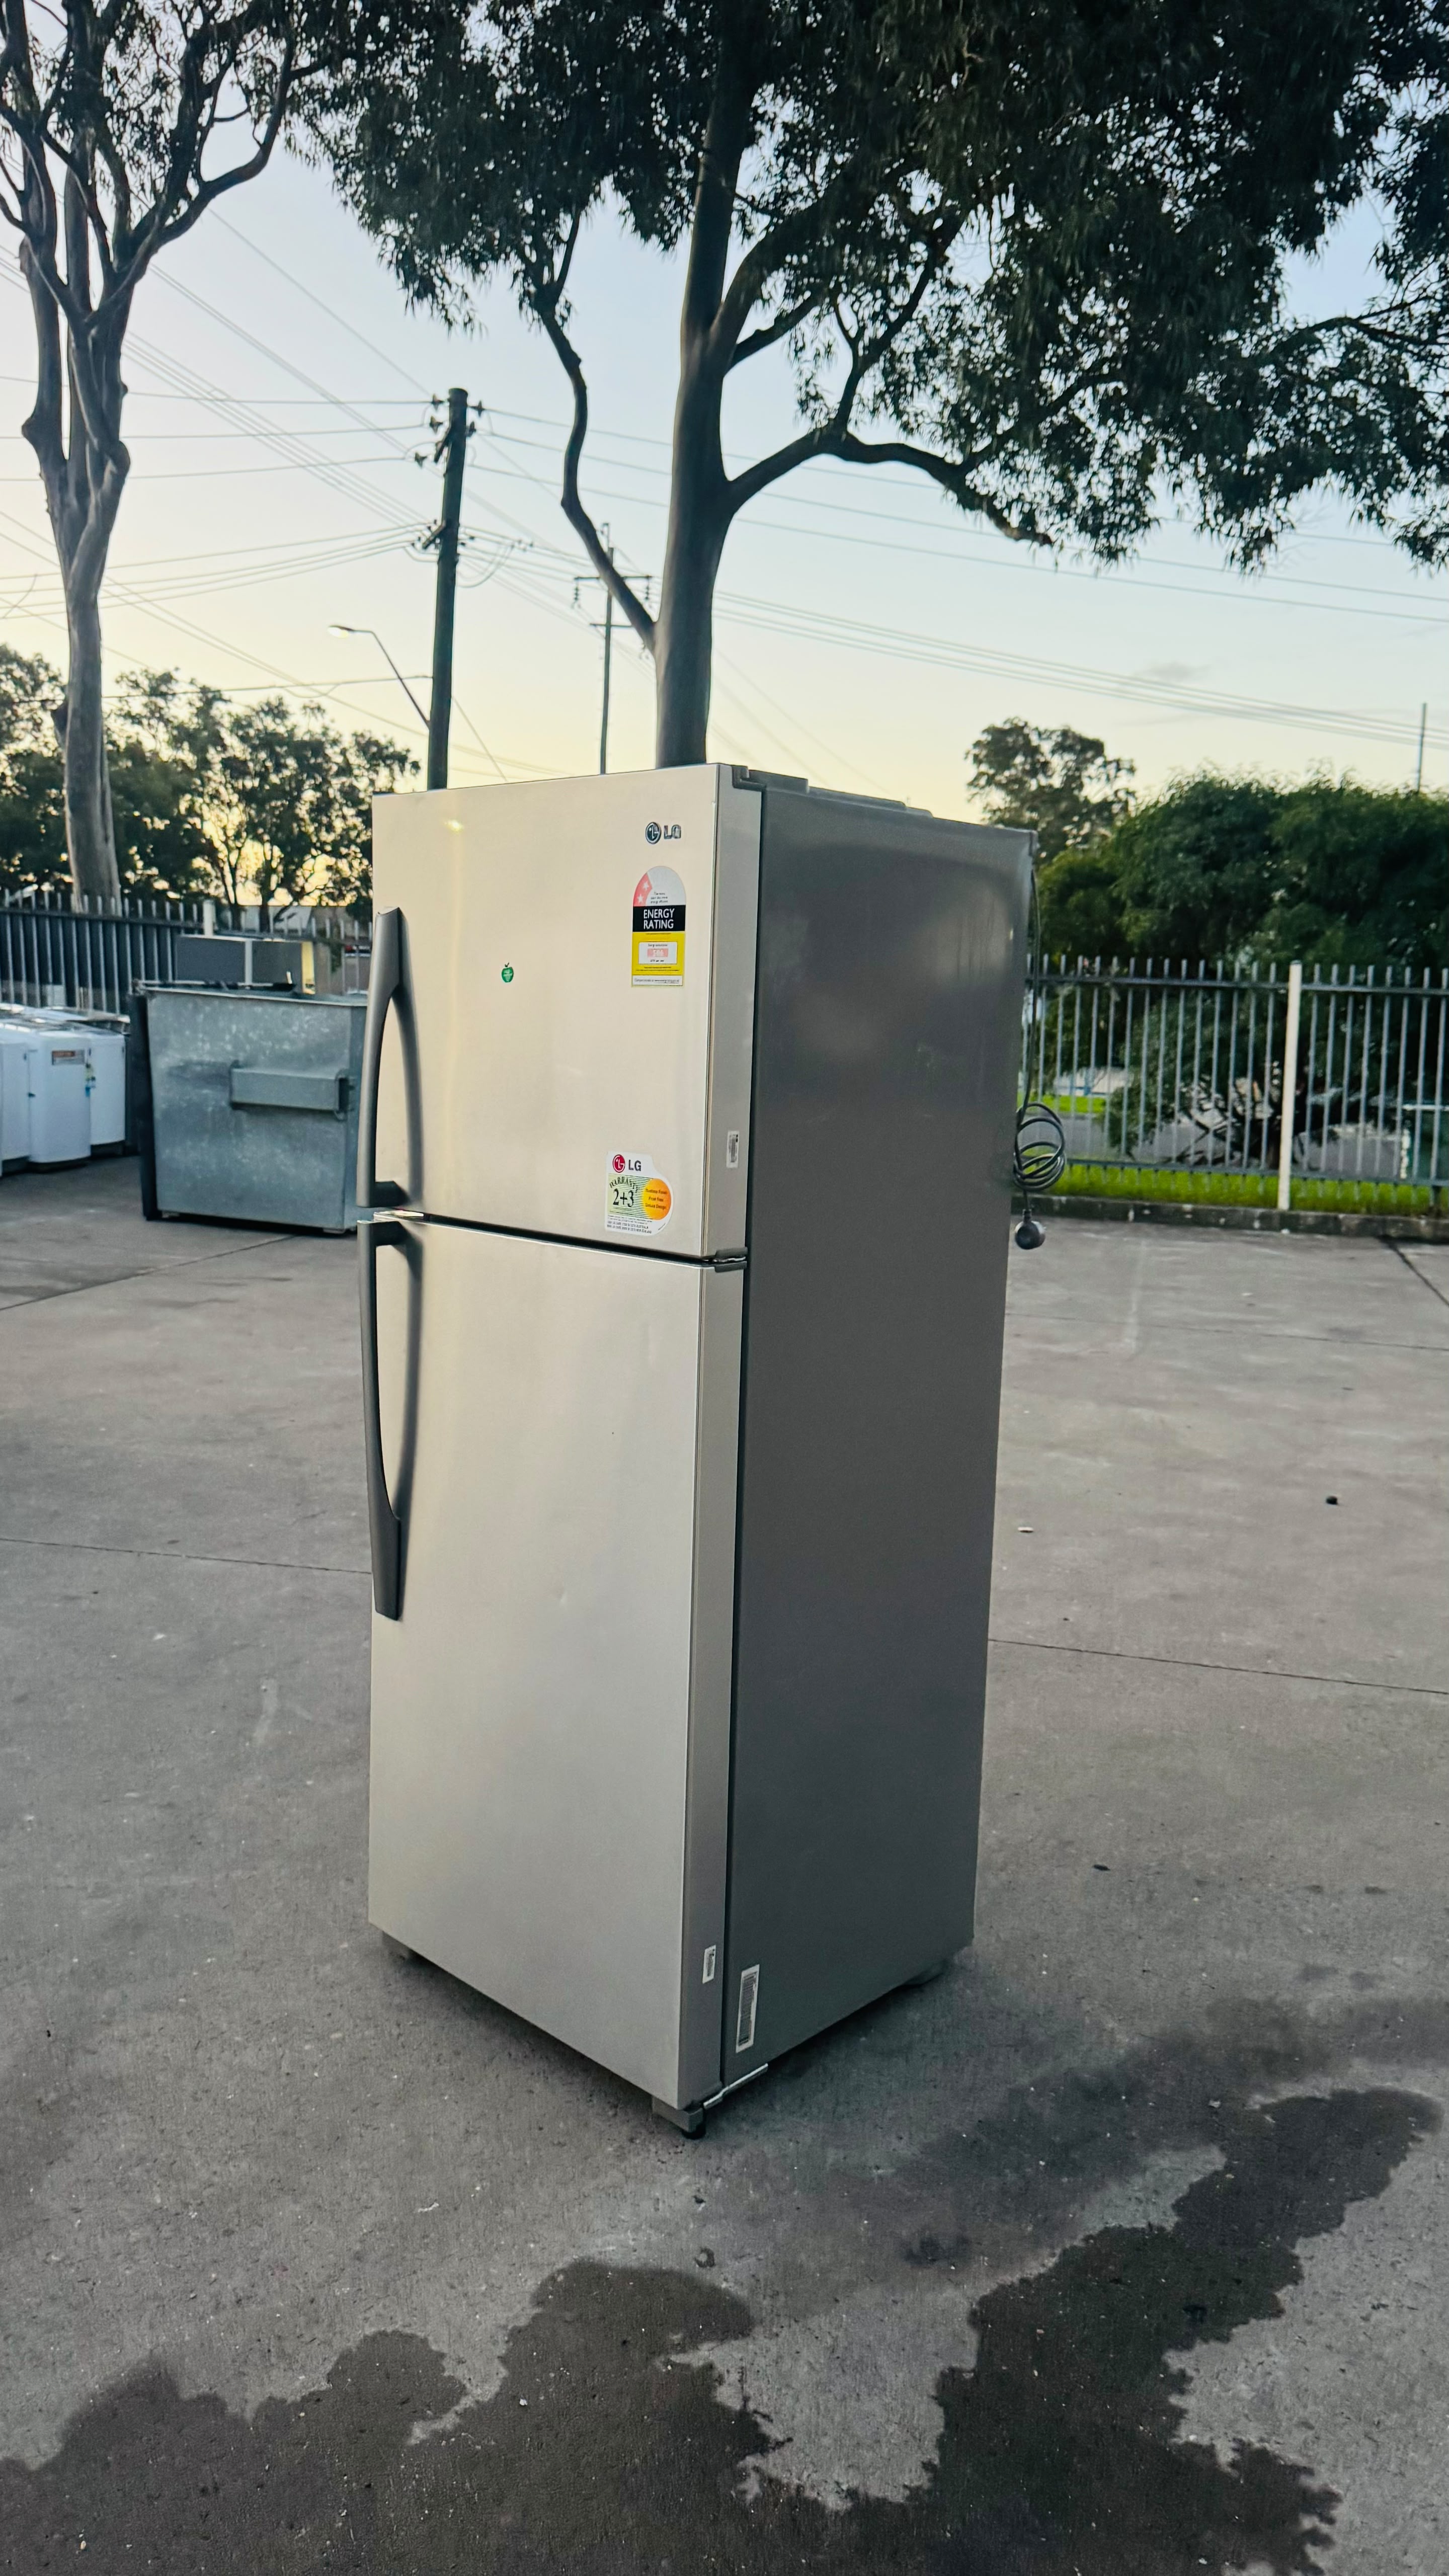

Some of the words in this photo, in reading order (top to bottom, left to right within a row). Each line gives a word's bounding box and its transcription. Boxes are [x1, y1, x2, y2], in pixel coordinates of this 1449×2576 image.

[643, 908, 675, 919] ENERGY
[643, 919, 674, 930] RATING
[628, 1159, 641, 1171] LG
[613, 1188, 634, 1208] 2+3
